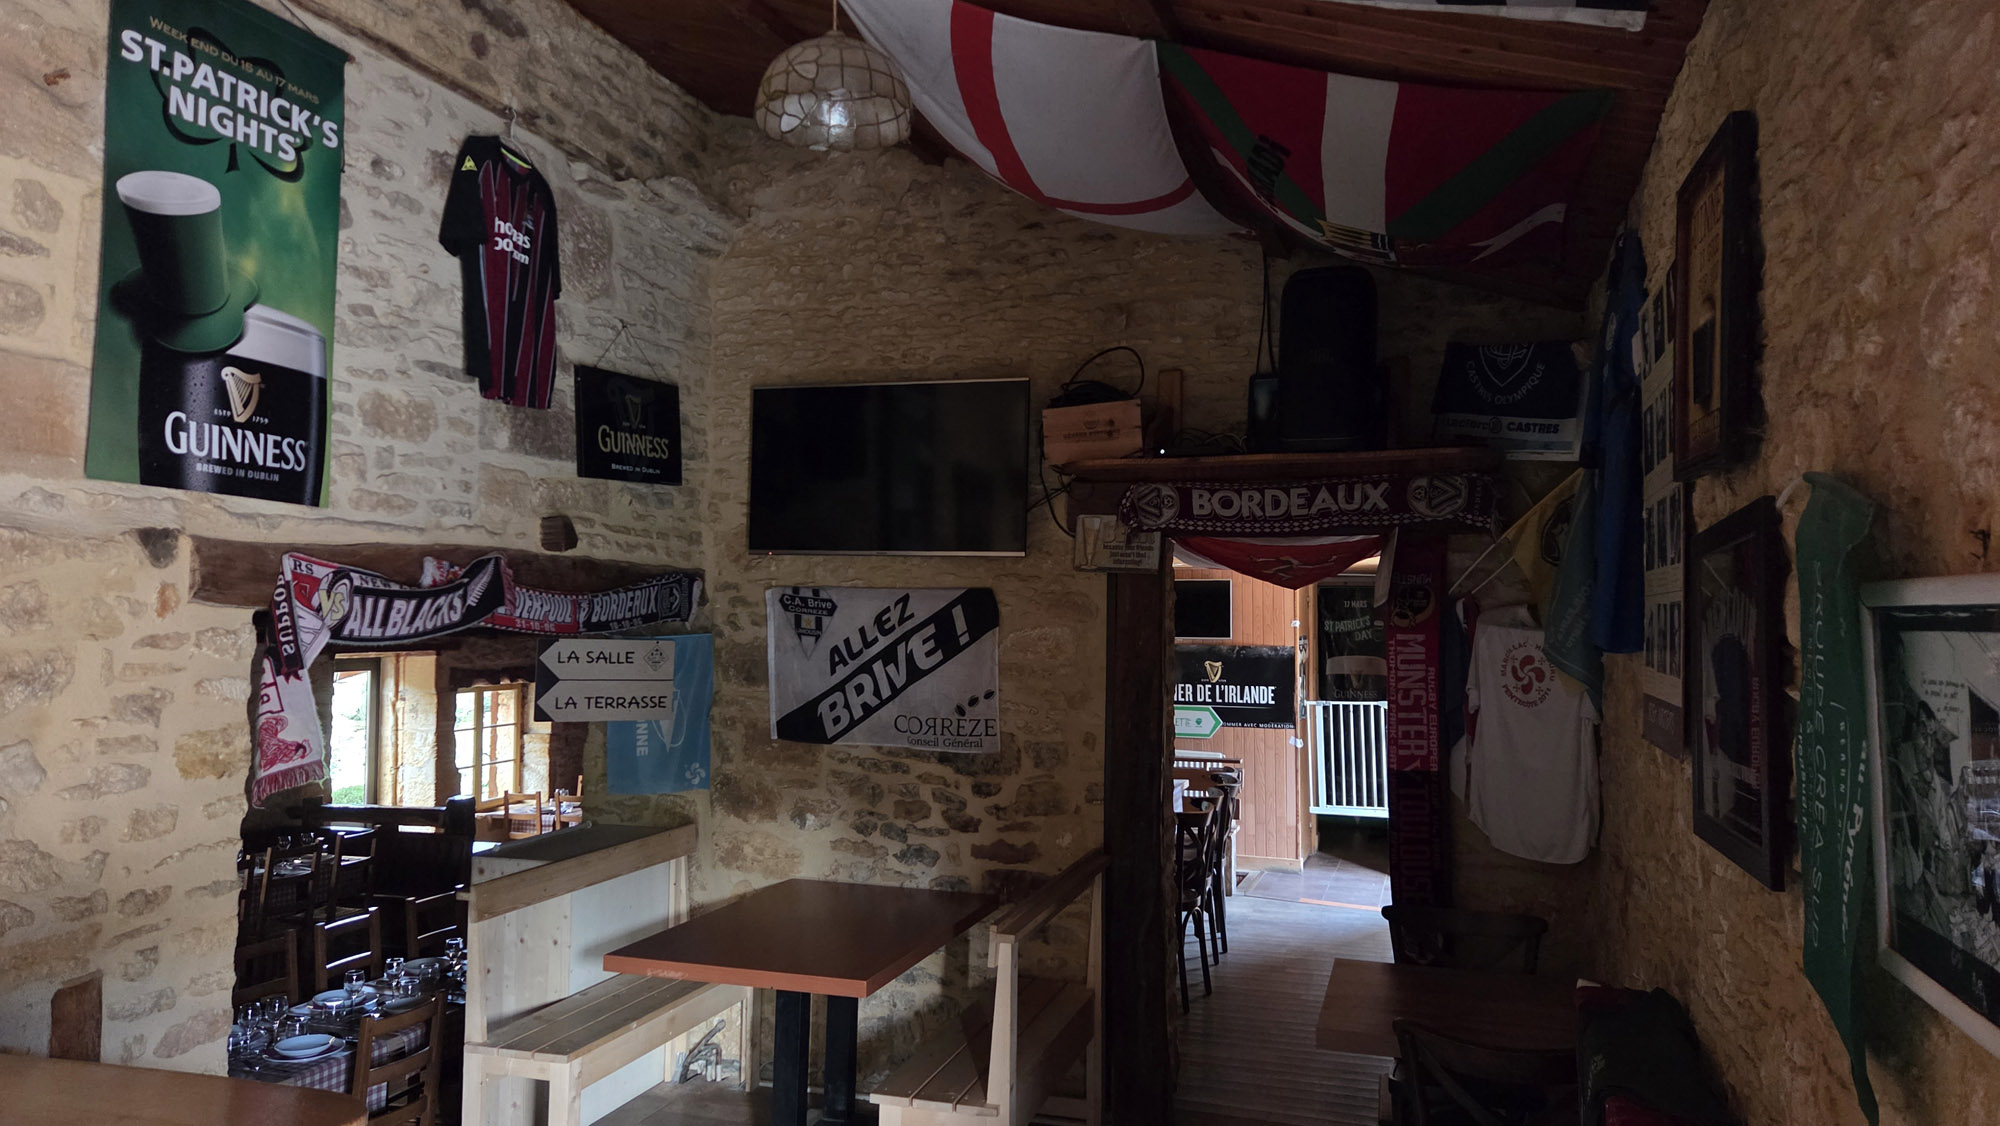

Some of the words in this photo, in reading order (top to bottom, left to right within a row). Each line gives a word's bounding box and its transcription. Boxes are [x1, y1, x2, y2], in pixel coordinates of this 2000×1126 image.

[149, 15, 188, 44] WEEK
[190, 37, 219, 57] END
[221, 51, 239, 66] DU
[256, 68, 273, 82] AU
[275, 76, 287, 89] 17
[287, 83, 320, 105] MARS
[168, 85, 298, 163] NIGHTS
[1494, 362, 1546, 405] OLYMPIQUE
[164, 410, 307, 473] GUINNESS
[598, 424, 669, 461] GUINNESS
[1506, 421, 1560, 434] CASTRES
[196, 462, 233, 477] BREWED
[235, 468, 245, 479] IN
[247, 469, 280, 482] DUBLIN
[1191, 482, 1391, 521] BORDEAUX
[342, 596, 387, 638] ALL
[383, 586, 463, 638] BLACKS
[591, 585, 659, 622] BORDEAUX
[807, 598, 833, 610] Brive
[830, 593, 915, 676] ALLEZ
[1354, 629, 1372, 641] DAY
[558, 650, 579, 664] LA
[585, 650, 635, 664] SALLE
[817, 623, 943, 740] BRIVE
[1197, 684, 1212, 703] DE
[1215, 684, 1276, 705] L'IRLANDE
[1334, 688, 1378, 700] GUINNESS
[1396, 634, 1429, 756] MUNSTER
[1427, 667, 1438, 709] RUGBY
[555, 696, 577, 710] LA
[584, 695, 667, 710] TERRASSE
[907, 735, 939, 747] Conseil
[943, 737, 983, 749] Général
